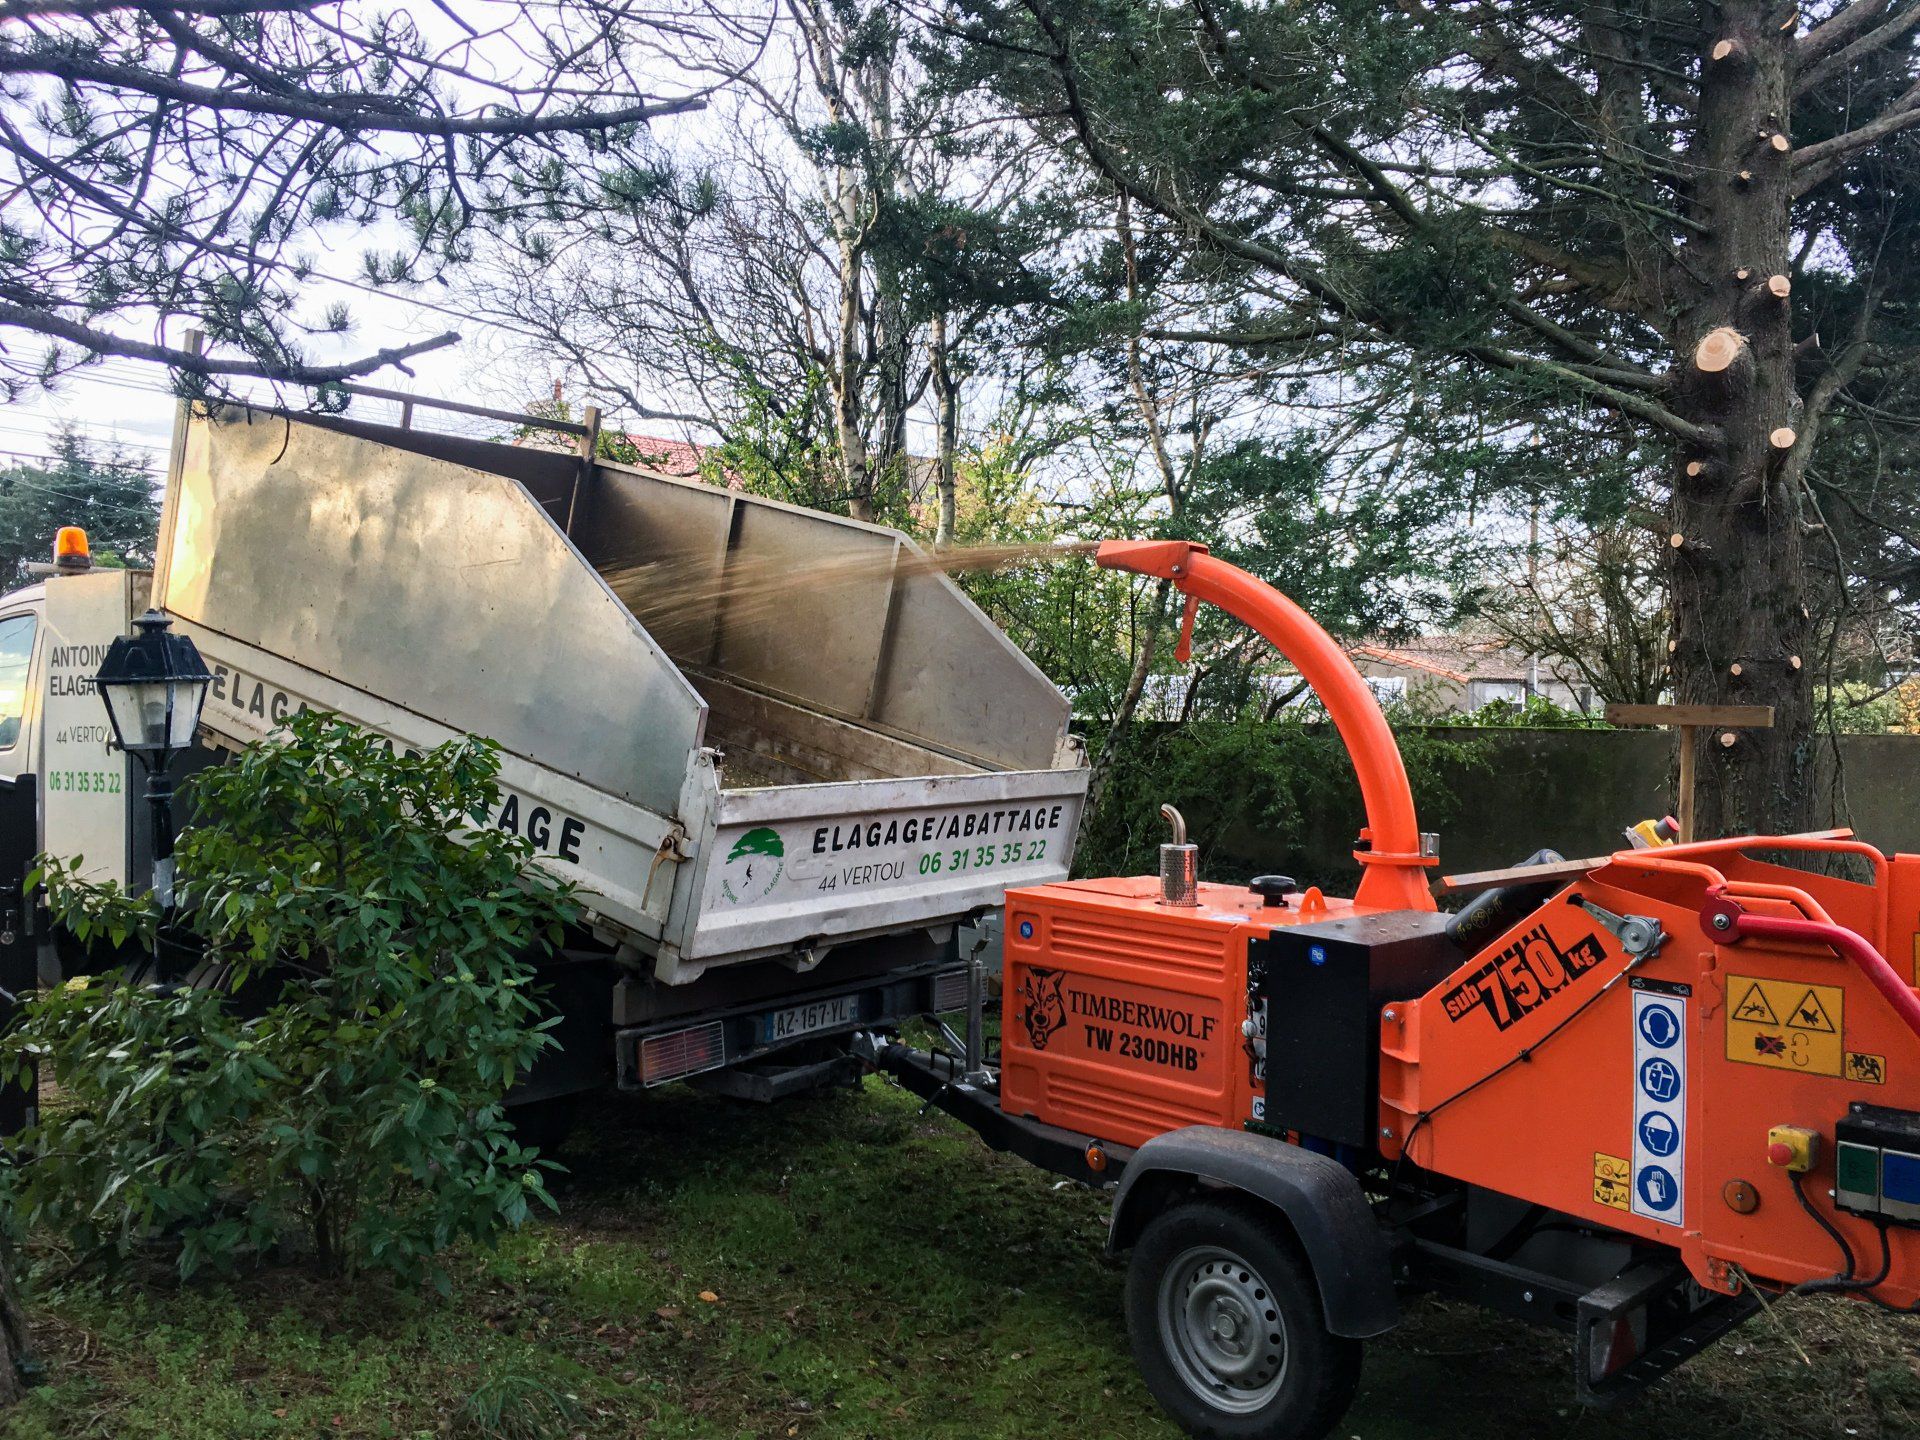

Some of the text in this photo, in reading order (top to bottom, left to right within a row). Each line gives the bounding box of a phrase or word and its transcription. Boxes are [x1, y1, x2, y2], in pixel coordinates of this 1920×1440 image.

[50, 644, 112, 668] ANTOIN
[56, 731, 67, 744] 44
[49, 771, 121, 793] 06 31 35 35 22
[812, 805, 1063, 854] ELAGAGE/ABATTAGE
[919, 839, 1047, 875] 06 31 35 35 22
[818, 861, 905, 891] 44 VERTOU
[1445, 937, 1597, 1026] sub 750 kg
[1068, 988, 1217, 1041] TIMBERWOLF
[1084, 1024, 1199, 1072] TW 230DHB
